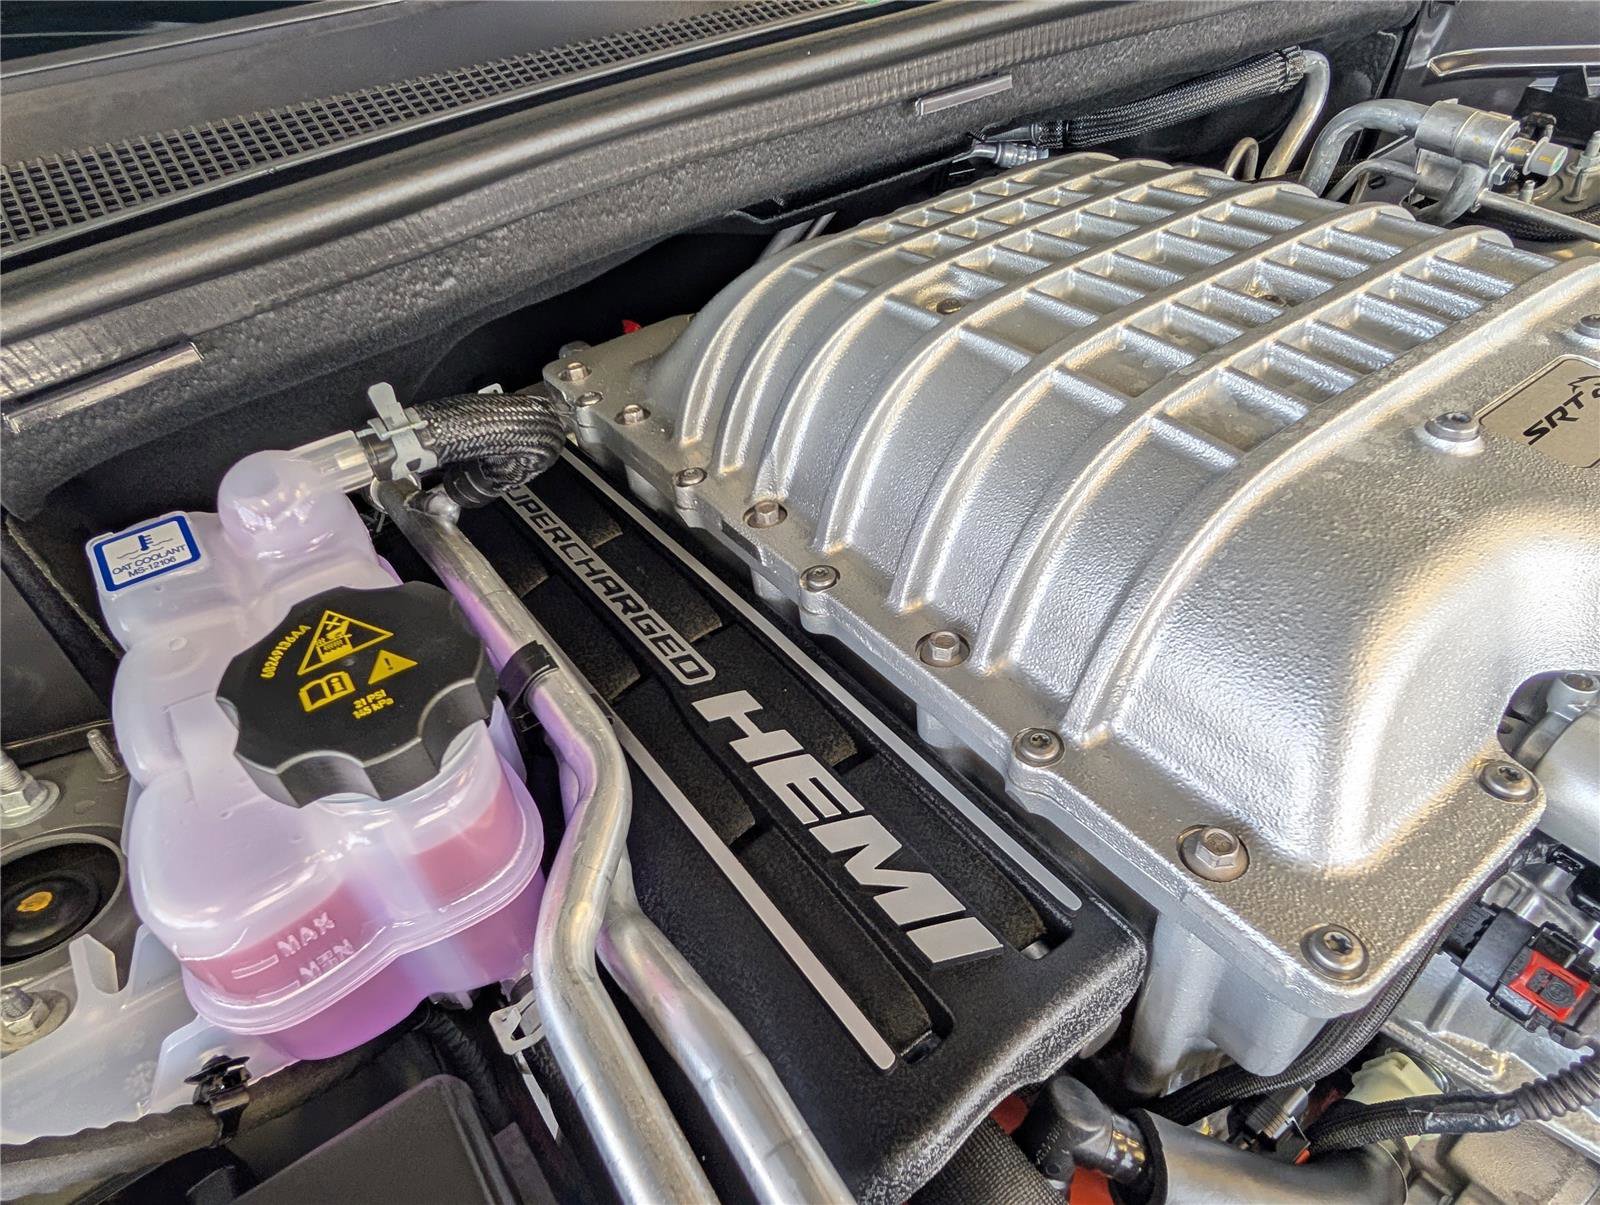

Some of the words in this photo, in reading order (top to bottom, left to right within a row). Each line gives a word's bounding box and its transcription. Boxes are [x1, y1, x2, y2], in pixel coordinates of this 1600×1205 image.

[1523, 390, 1584, 446] SRT
[112, 562, 133, 575] OAT
[134, 544, 186, 567] COOLANT
[128, 557, 177, 578] MS-12106
[504, 484, 710, 680] UPERCHARGED
[366, 689, 387, 703] PSI
[691, 690, 1004, 963] HEMI
[277, 911, 335, 957] MAX
[299, 938, 355, 981] MIN
